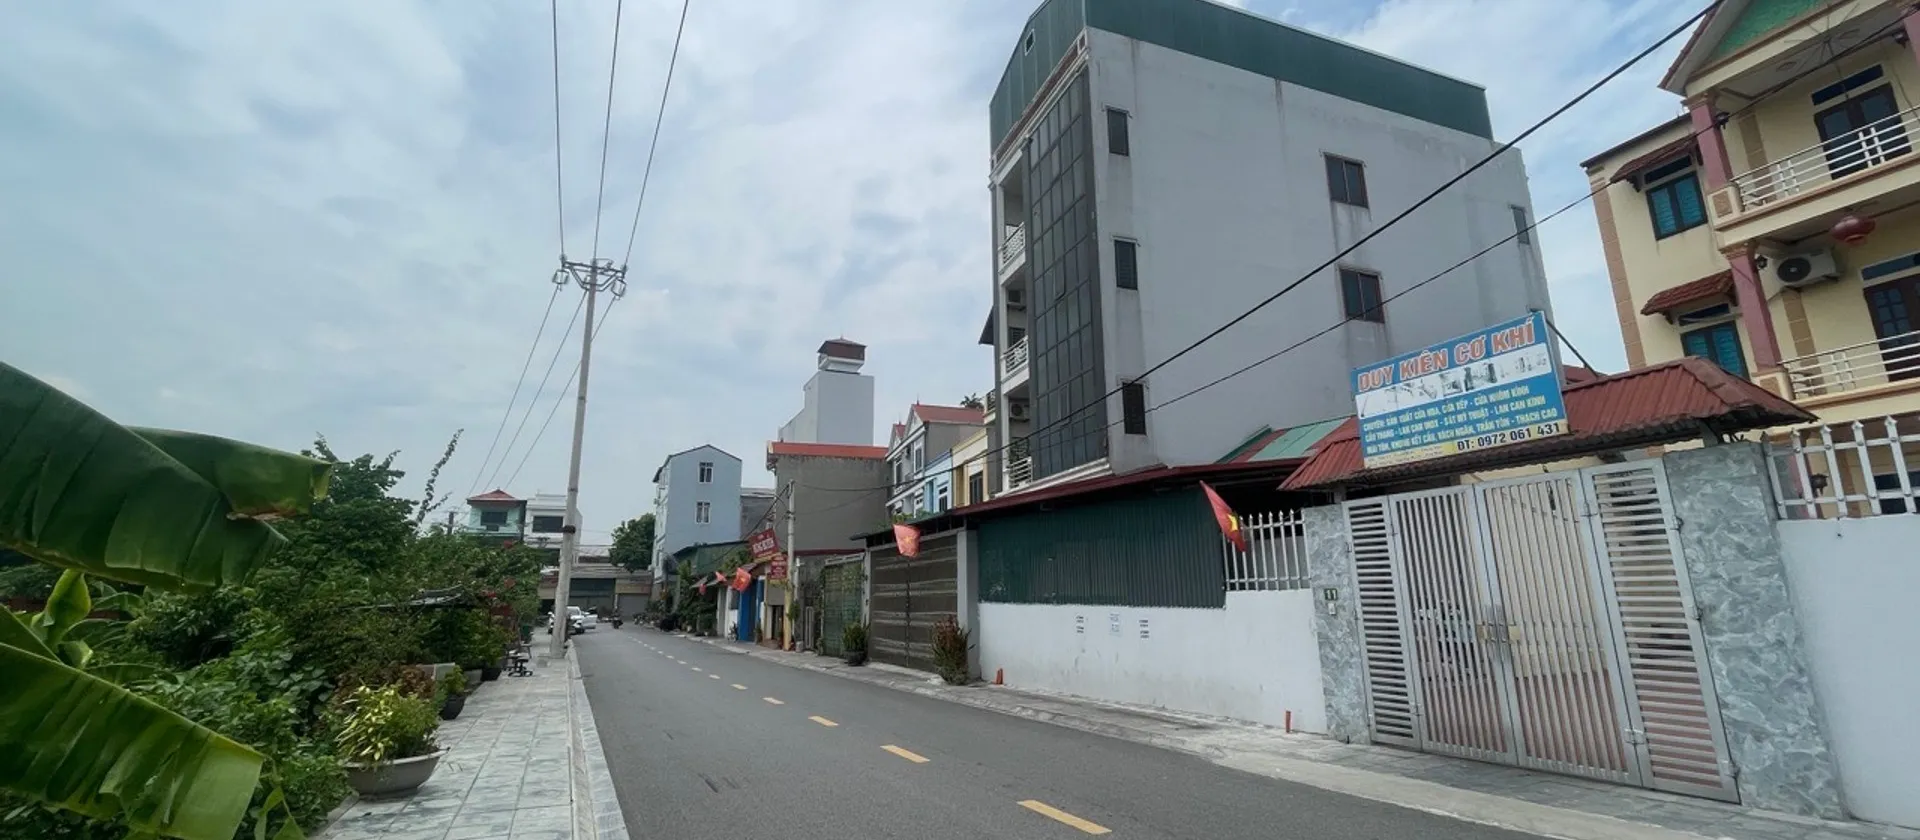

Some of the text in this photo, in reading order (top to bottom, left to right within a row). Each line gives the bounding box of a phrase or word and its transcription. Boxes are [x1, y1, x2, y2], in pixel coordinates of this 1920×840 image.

[1358, 317, 1535, 392] DUY KIÊN CƠ KHÍ
[1541, 408, 1558, 420] CAO
[1457, 423, 1560, 451] ĐT: 0972 061 431
[1325, 589, 1336, 600] 11
